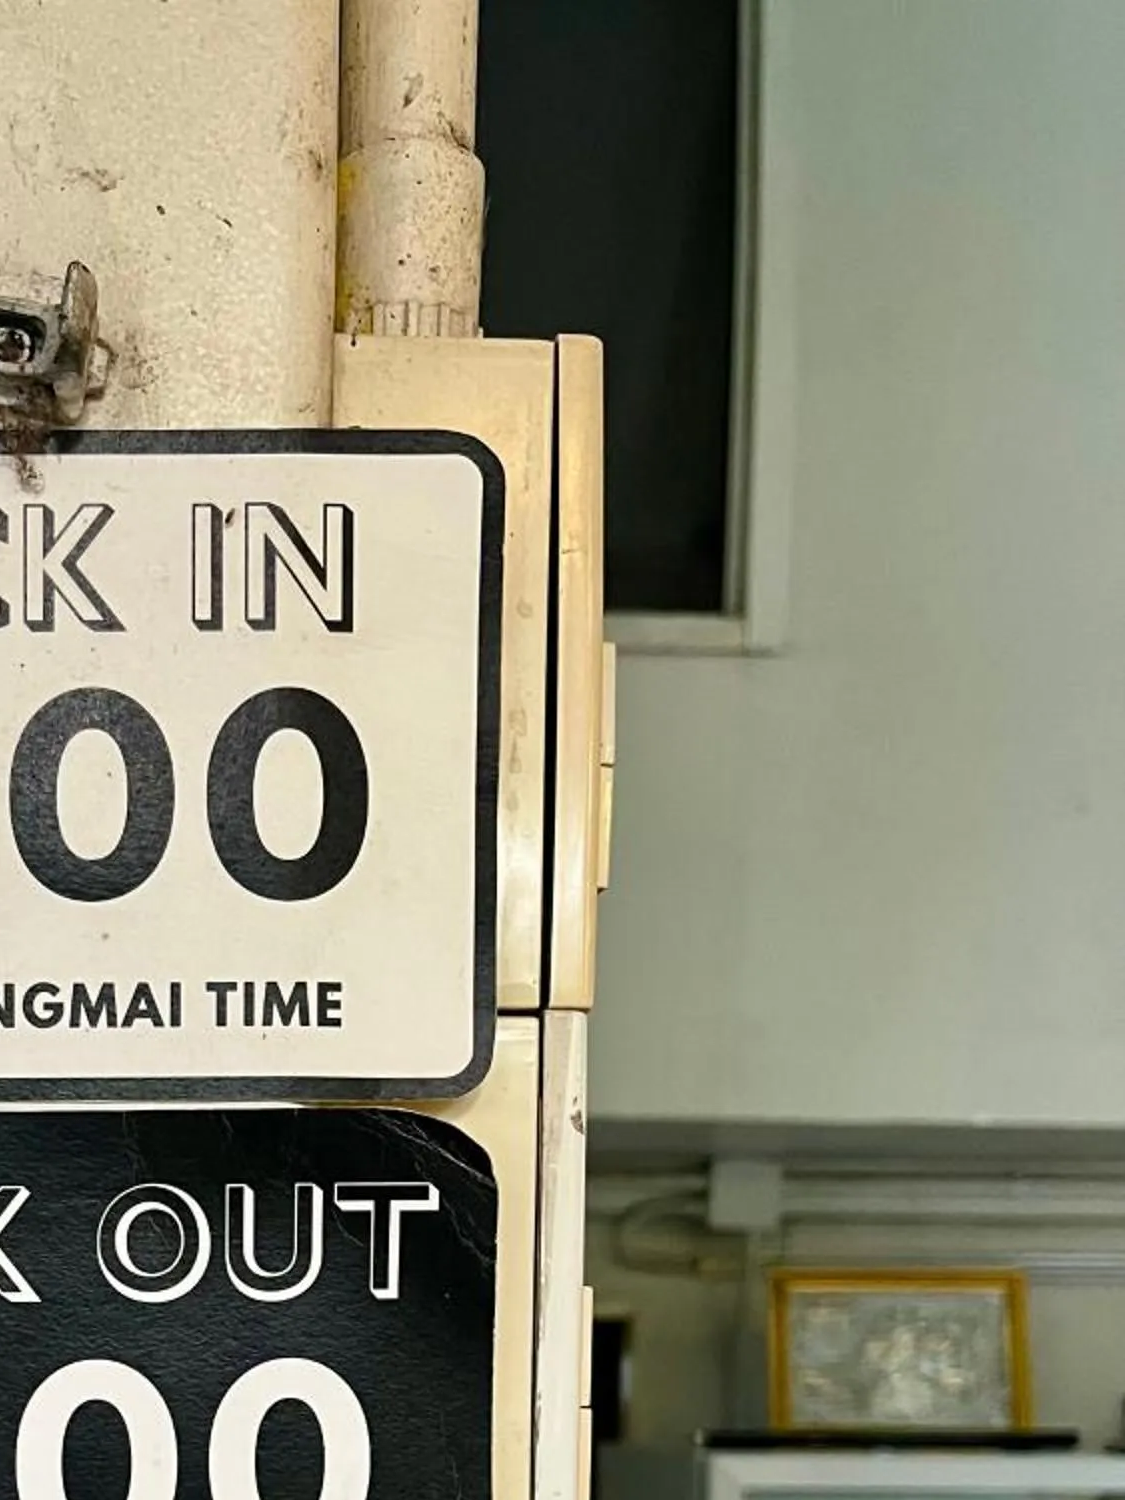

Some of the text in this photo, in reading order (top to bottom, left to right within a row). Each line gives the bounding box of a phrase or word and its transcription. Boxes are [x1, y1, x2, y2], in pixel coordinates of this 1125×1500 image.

[191, 501, 355, 634] IN
[205, 981, 343, 1028] TIME
[96, 1181, 440, 1304] OUT
